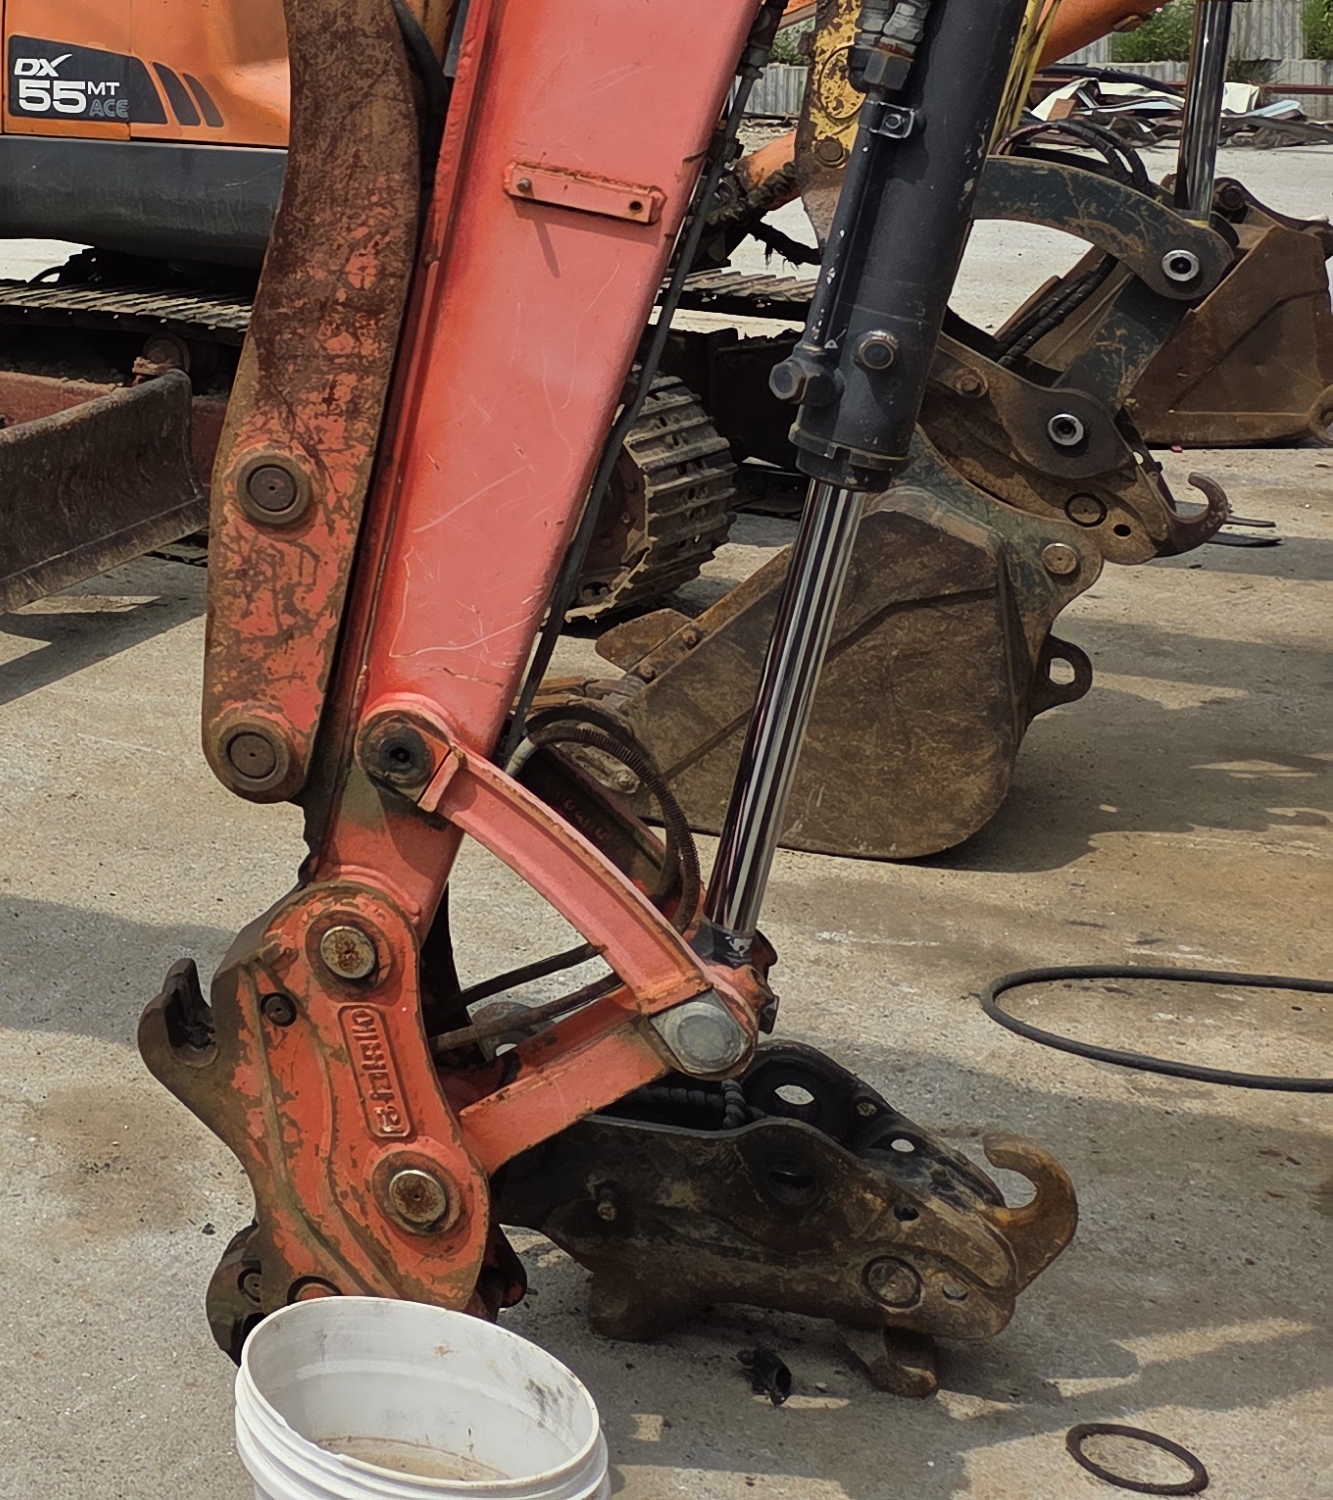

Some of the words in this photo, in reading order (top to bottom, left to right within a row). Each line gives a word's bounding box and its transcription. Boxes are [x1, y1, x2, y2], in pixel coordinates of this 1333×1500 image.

[14, 53, 73, 77] DX
[18, 79, 87, 114] 55
[87, 81, 120, 96] MT
[89, 98, 129, 118] ACE
